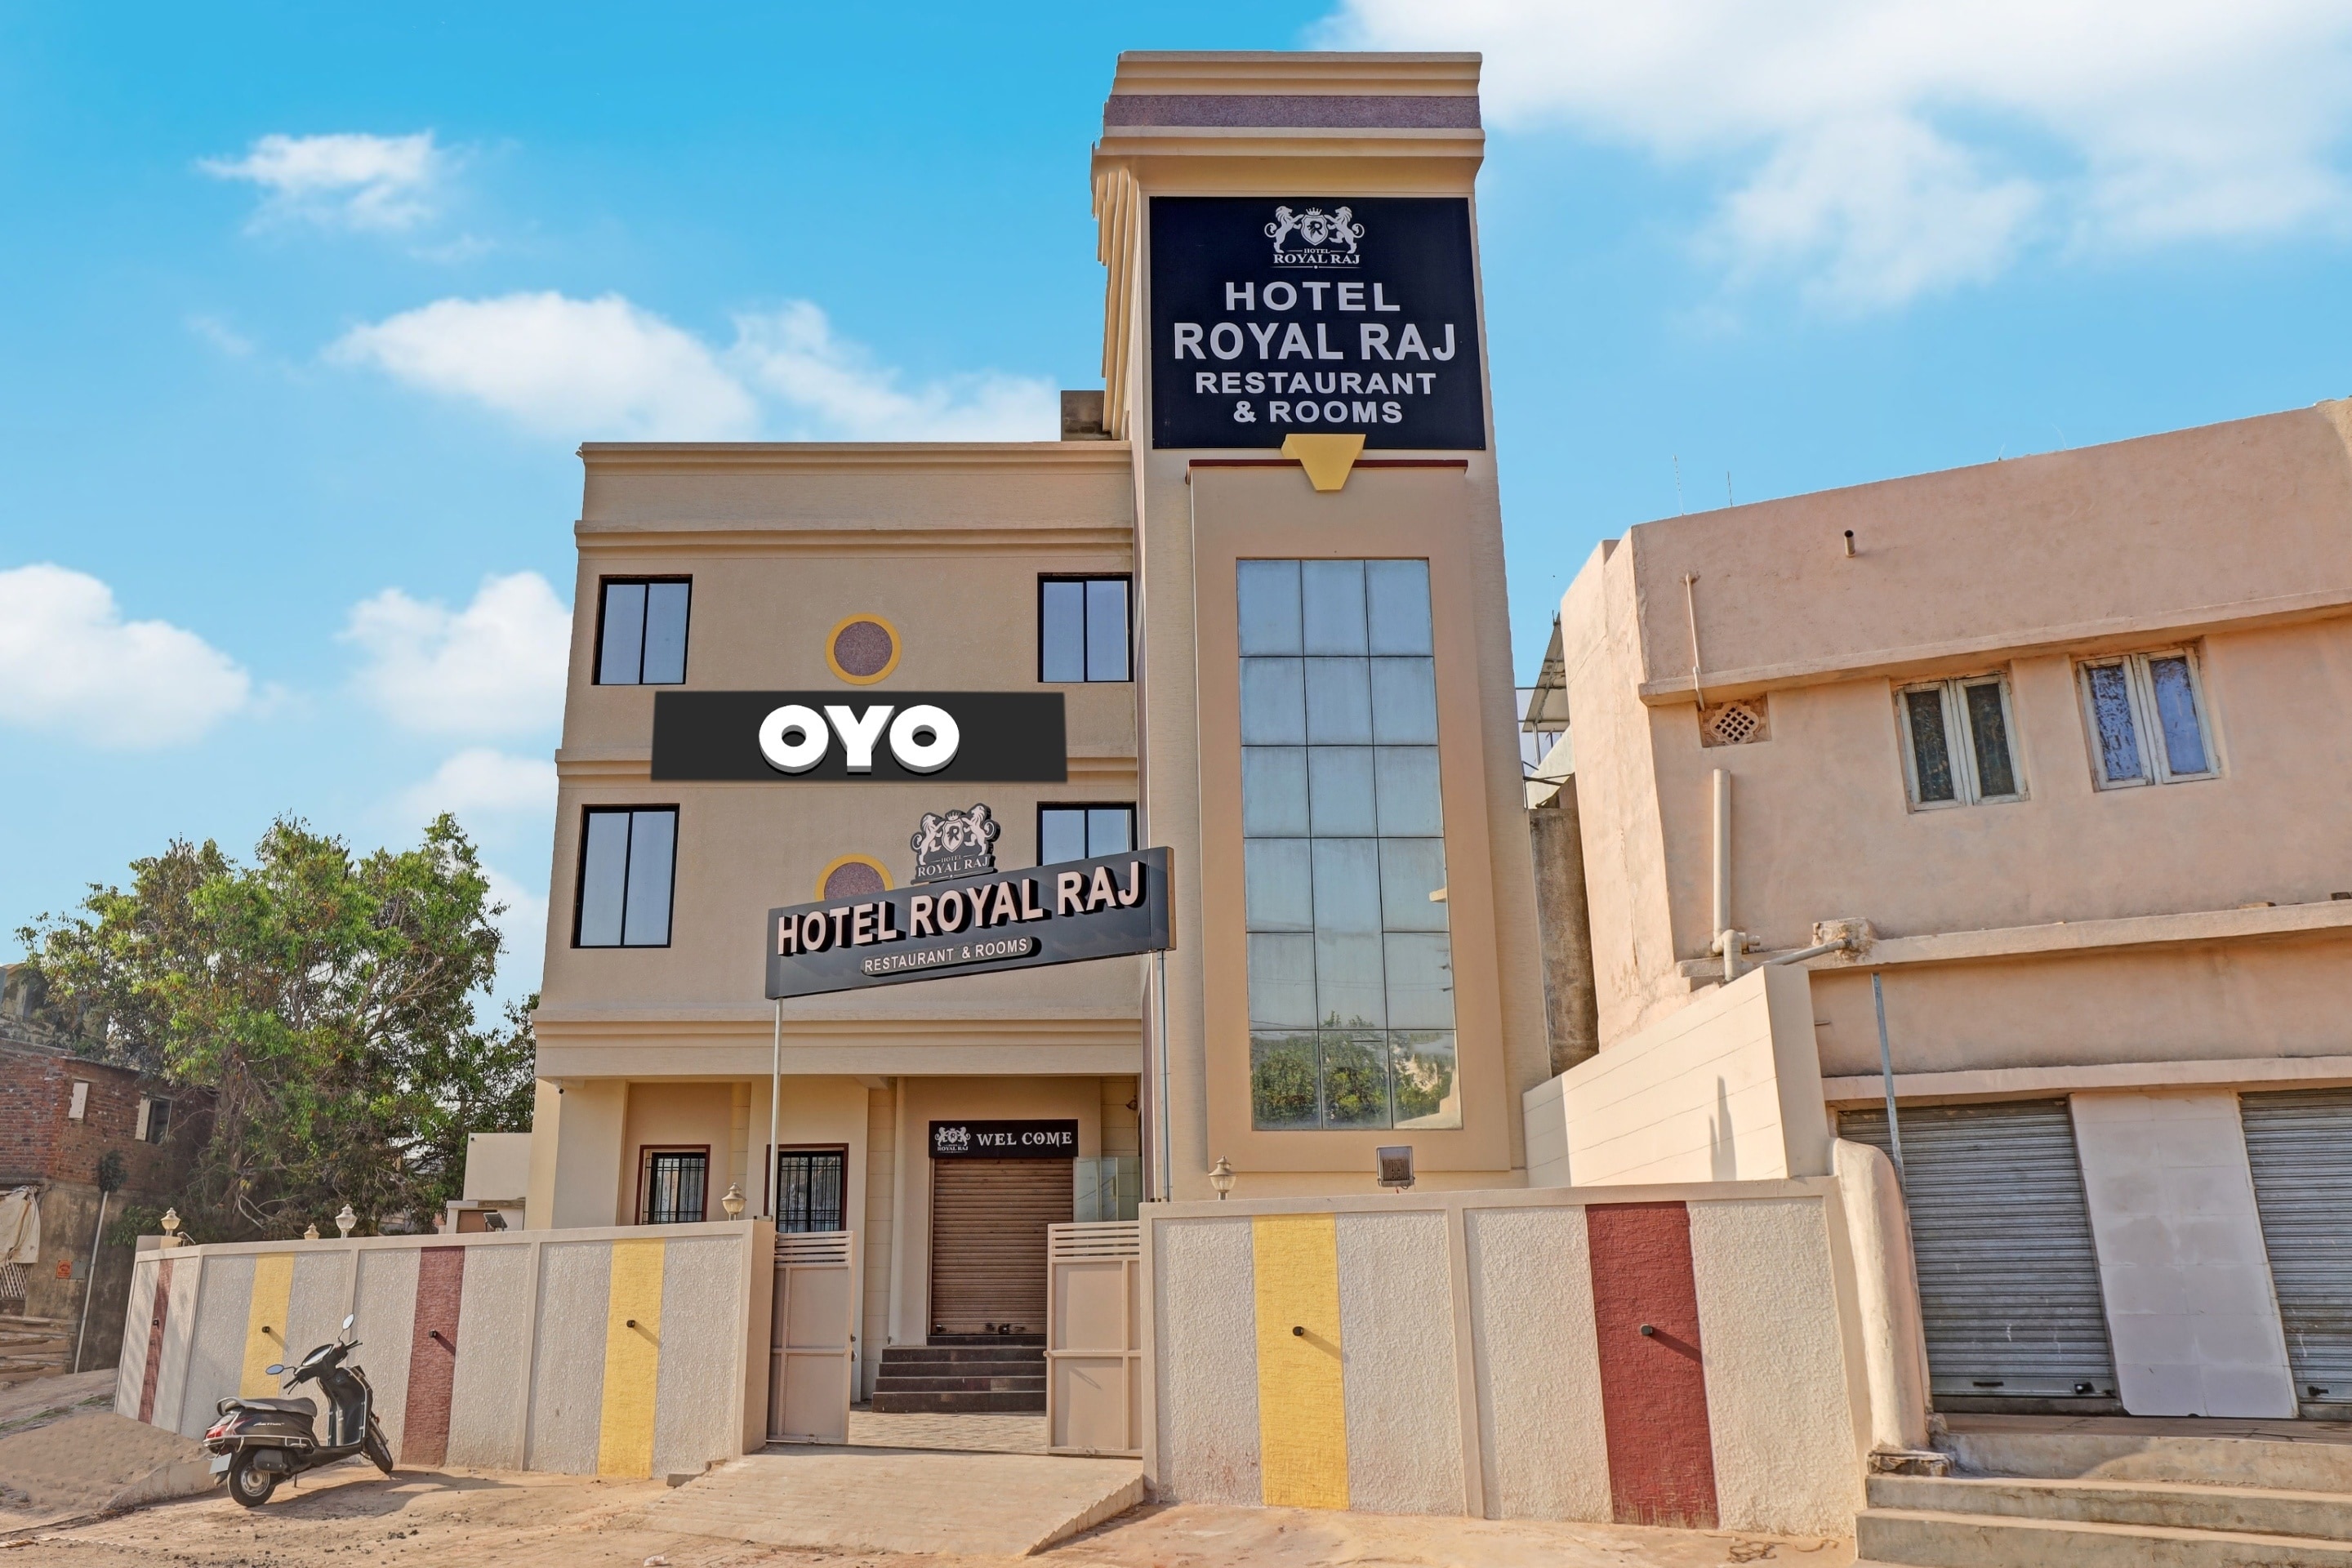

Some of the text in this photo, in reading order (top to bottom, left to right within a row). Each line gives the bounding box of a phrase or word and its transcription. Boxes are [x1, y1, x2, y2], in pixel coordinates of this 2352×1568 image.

[1273, 253, 1361, 265] ROYAL RAJ
[1225, 281, 1401, 312] HOTEL
[1174, 322, 1456, 361] ROYAL RAJ
[1196, 372, 1437, 394] RESTAURANT
[1233, 400, 1403, 424] & ROOMS
[759, 704, 960, 774] OYO
[917, 856, 989, 877] ROYAL RAJ
[941, 854, 963, 863] HOTEL
[777, 861, 1140, 956] HOTEL ROYAL RAJ
[864, 938, 1028, 973] RESTAURANT & ROOMS
